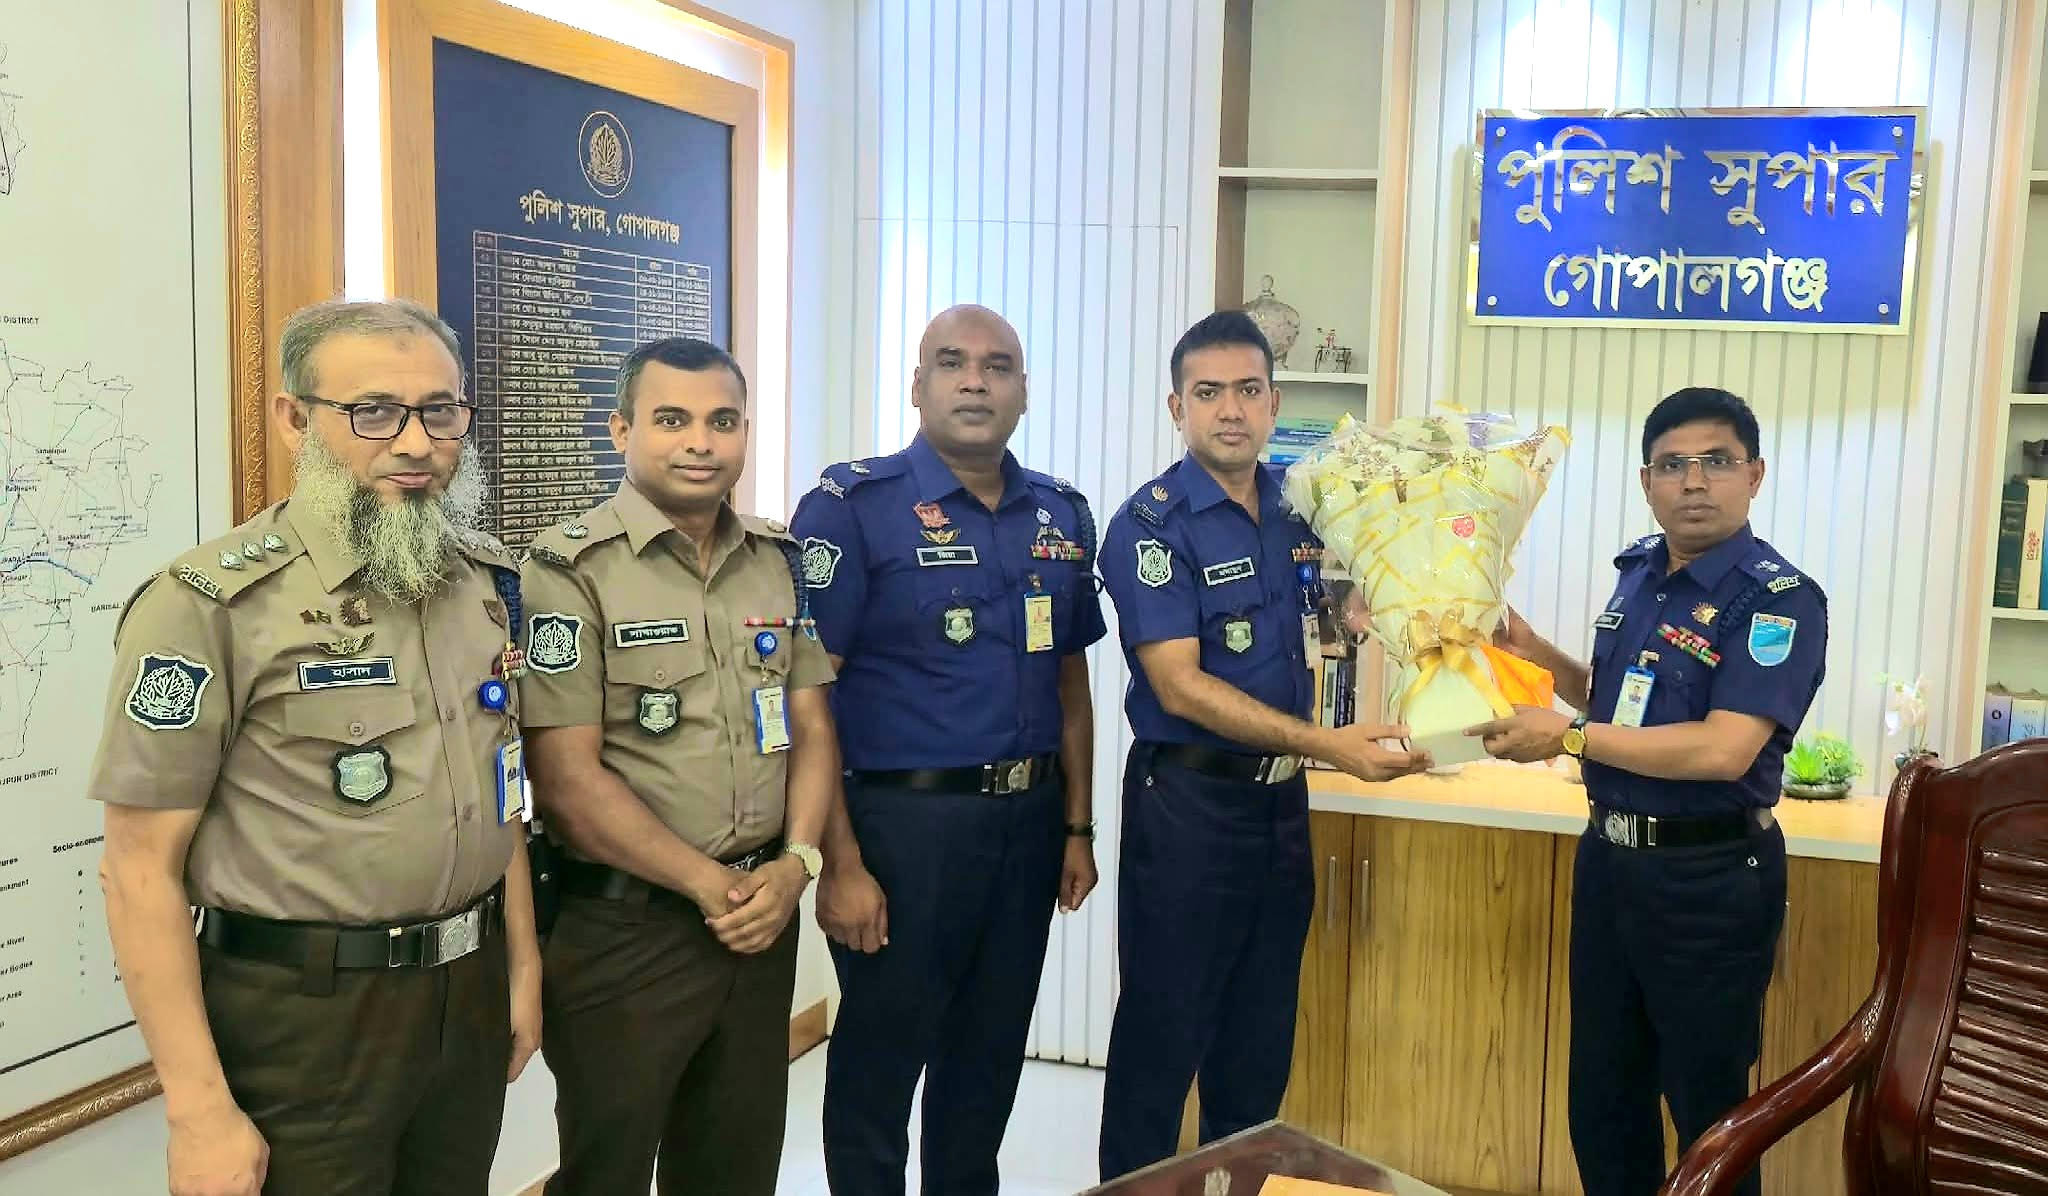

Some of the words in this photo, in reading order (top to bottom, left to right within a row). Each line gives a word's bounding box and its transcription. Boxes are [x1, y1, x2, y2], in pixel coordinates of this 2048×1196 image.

[1497, 126, 1685, 232] পুলিশ
[1703, 140, 1901, 234] সুপার
[519, 189, 563, 224] পুলিশ
[567, 203, 611, 236] সুপার,
[616, 211, 681, 244] গোপালগঞ্জ
[1543, 244, 1829, 313] গোপালগঞ্জ
